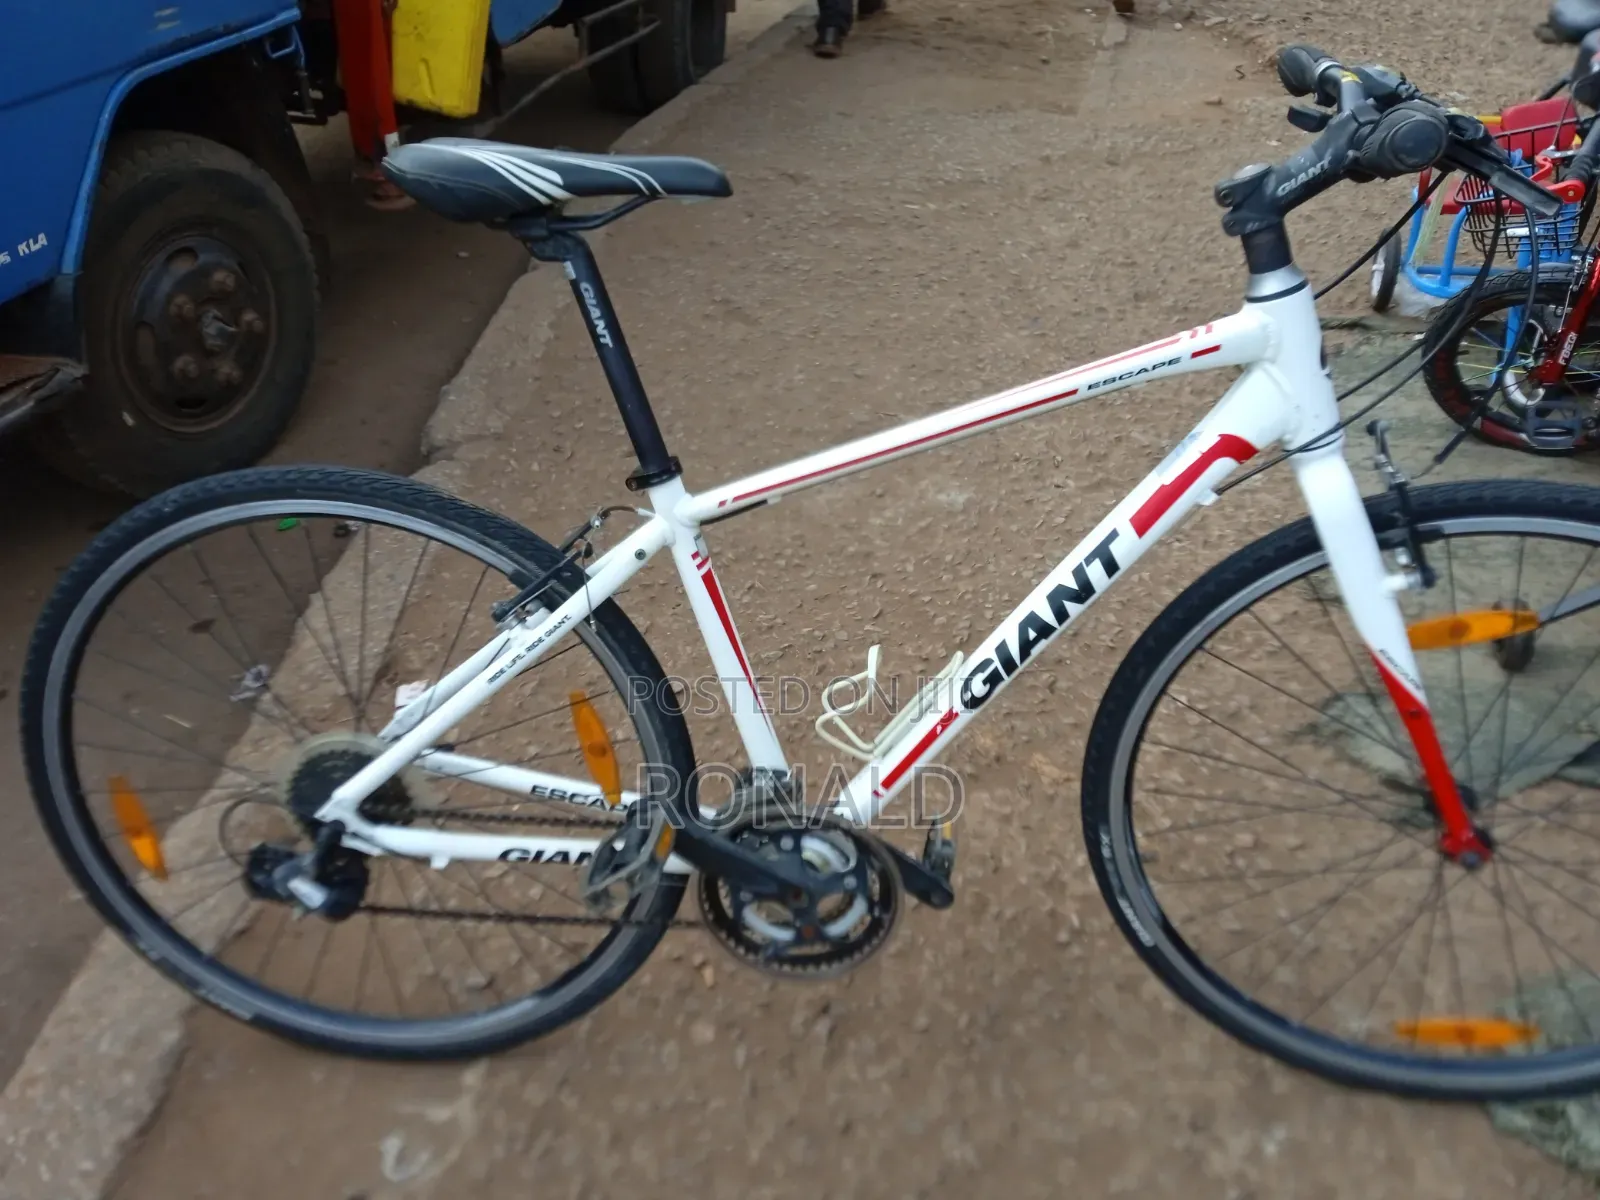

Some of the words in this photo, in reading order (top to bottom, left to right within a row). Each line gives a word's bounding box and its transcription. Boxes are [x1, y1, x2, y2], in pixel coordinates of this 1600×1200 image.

[1276, 154, 1333, 197] GIANT
[17, 232, 48, 257] KLA
[580, 282, 614, 349] GIANT
[1087, 356, 1183, 391] ESCAPE
[960, 527, 1121, 710] GIANT
[487, 667, 507, 684] RIDE
[525, 636, 545, 653] RIDE
